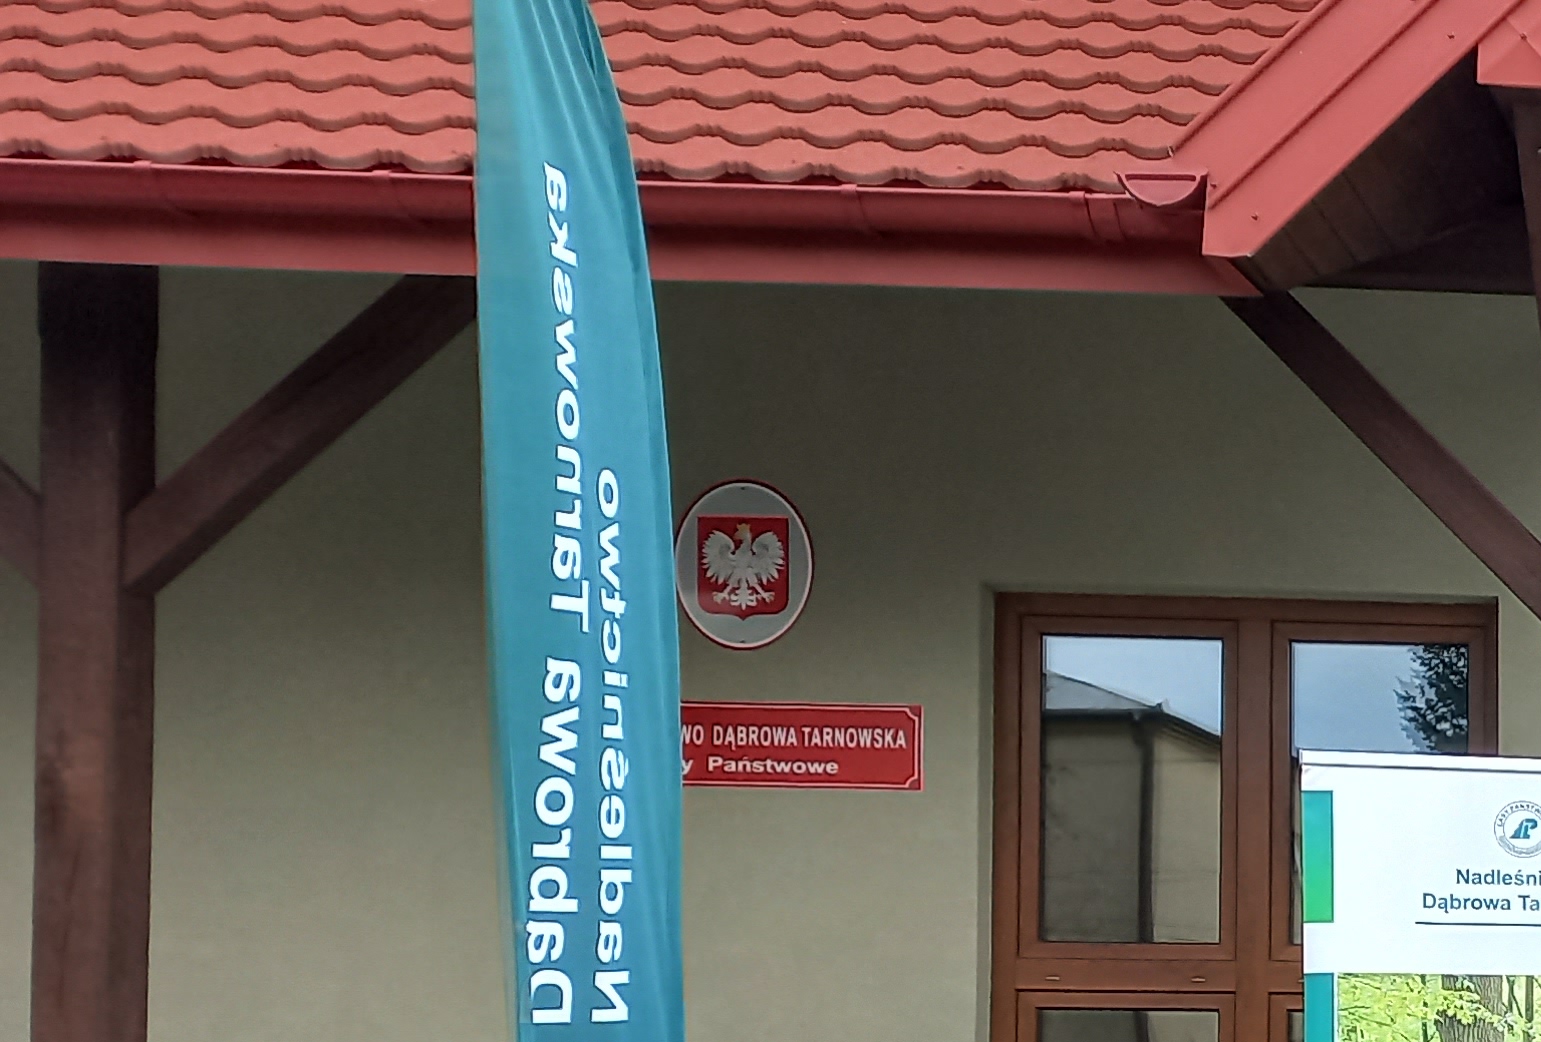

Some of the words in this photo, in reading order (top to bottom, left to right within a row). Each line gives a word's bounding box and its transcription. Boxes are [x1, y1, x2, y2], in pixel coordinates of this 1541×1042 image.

[712, 725, 798, 751] DĄBROWA
[801, 727, 907, 749] TARNOWSKA
[707, 756, 839, 774] Państwowe
[1422, 892, 1511, 914] Dąbrowa
